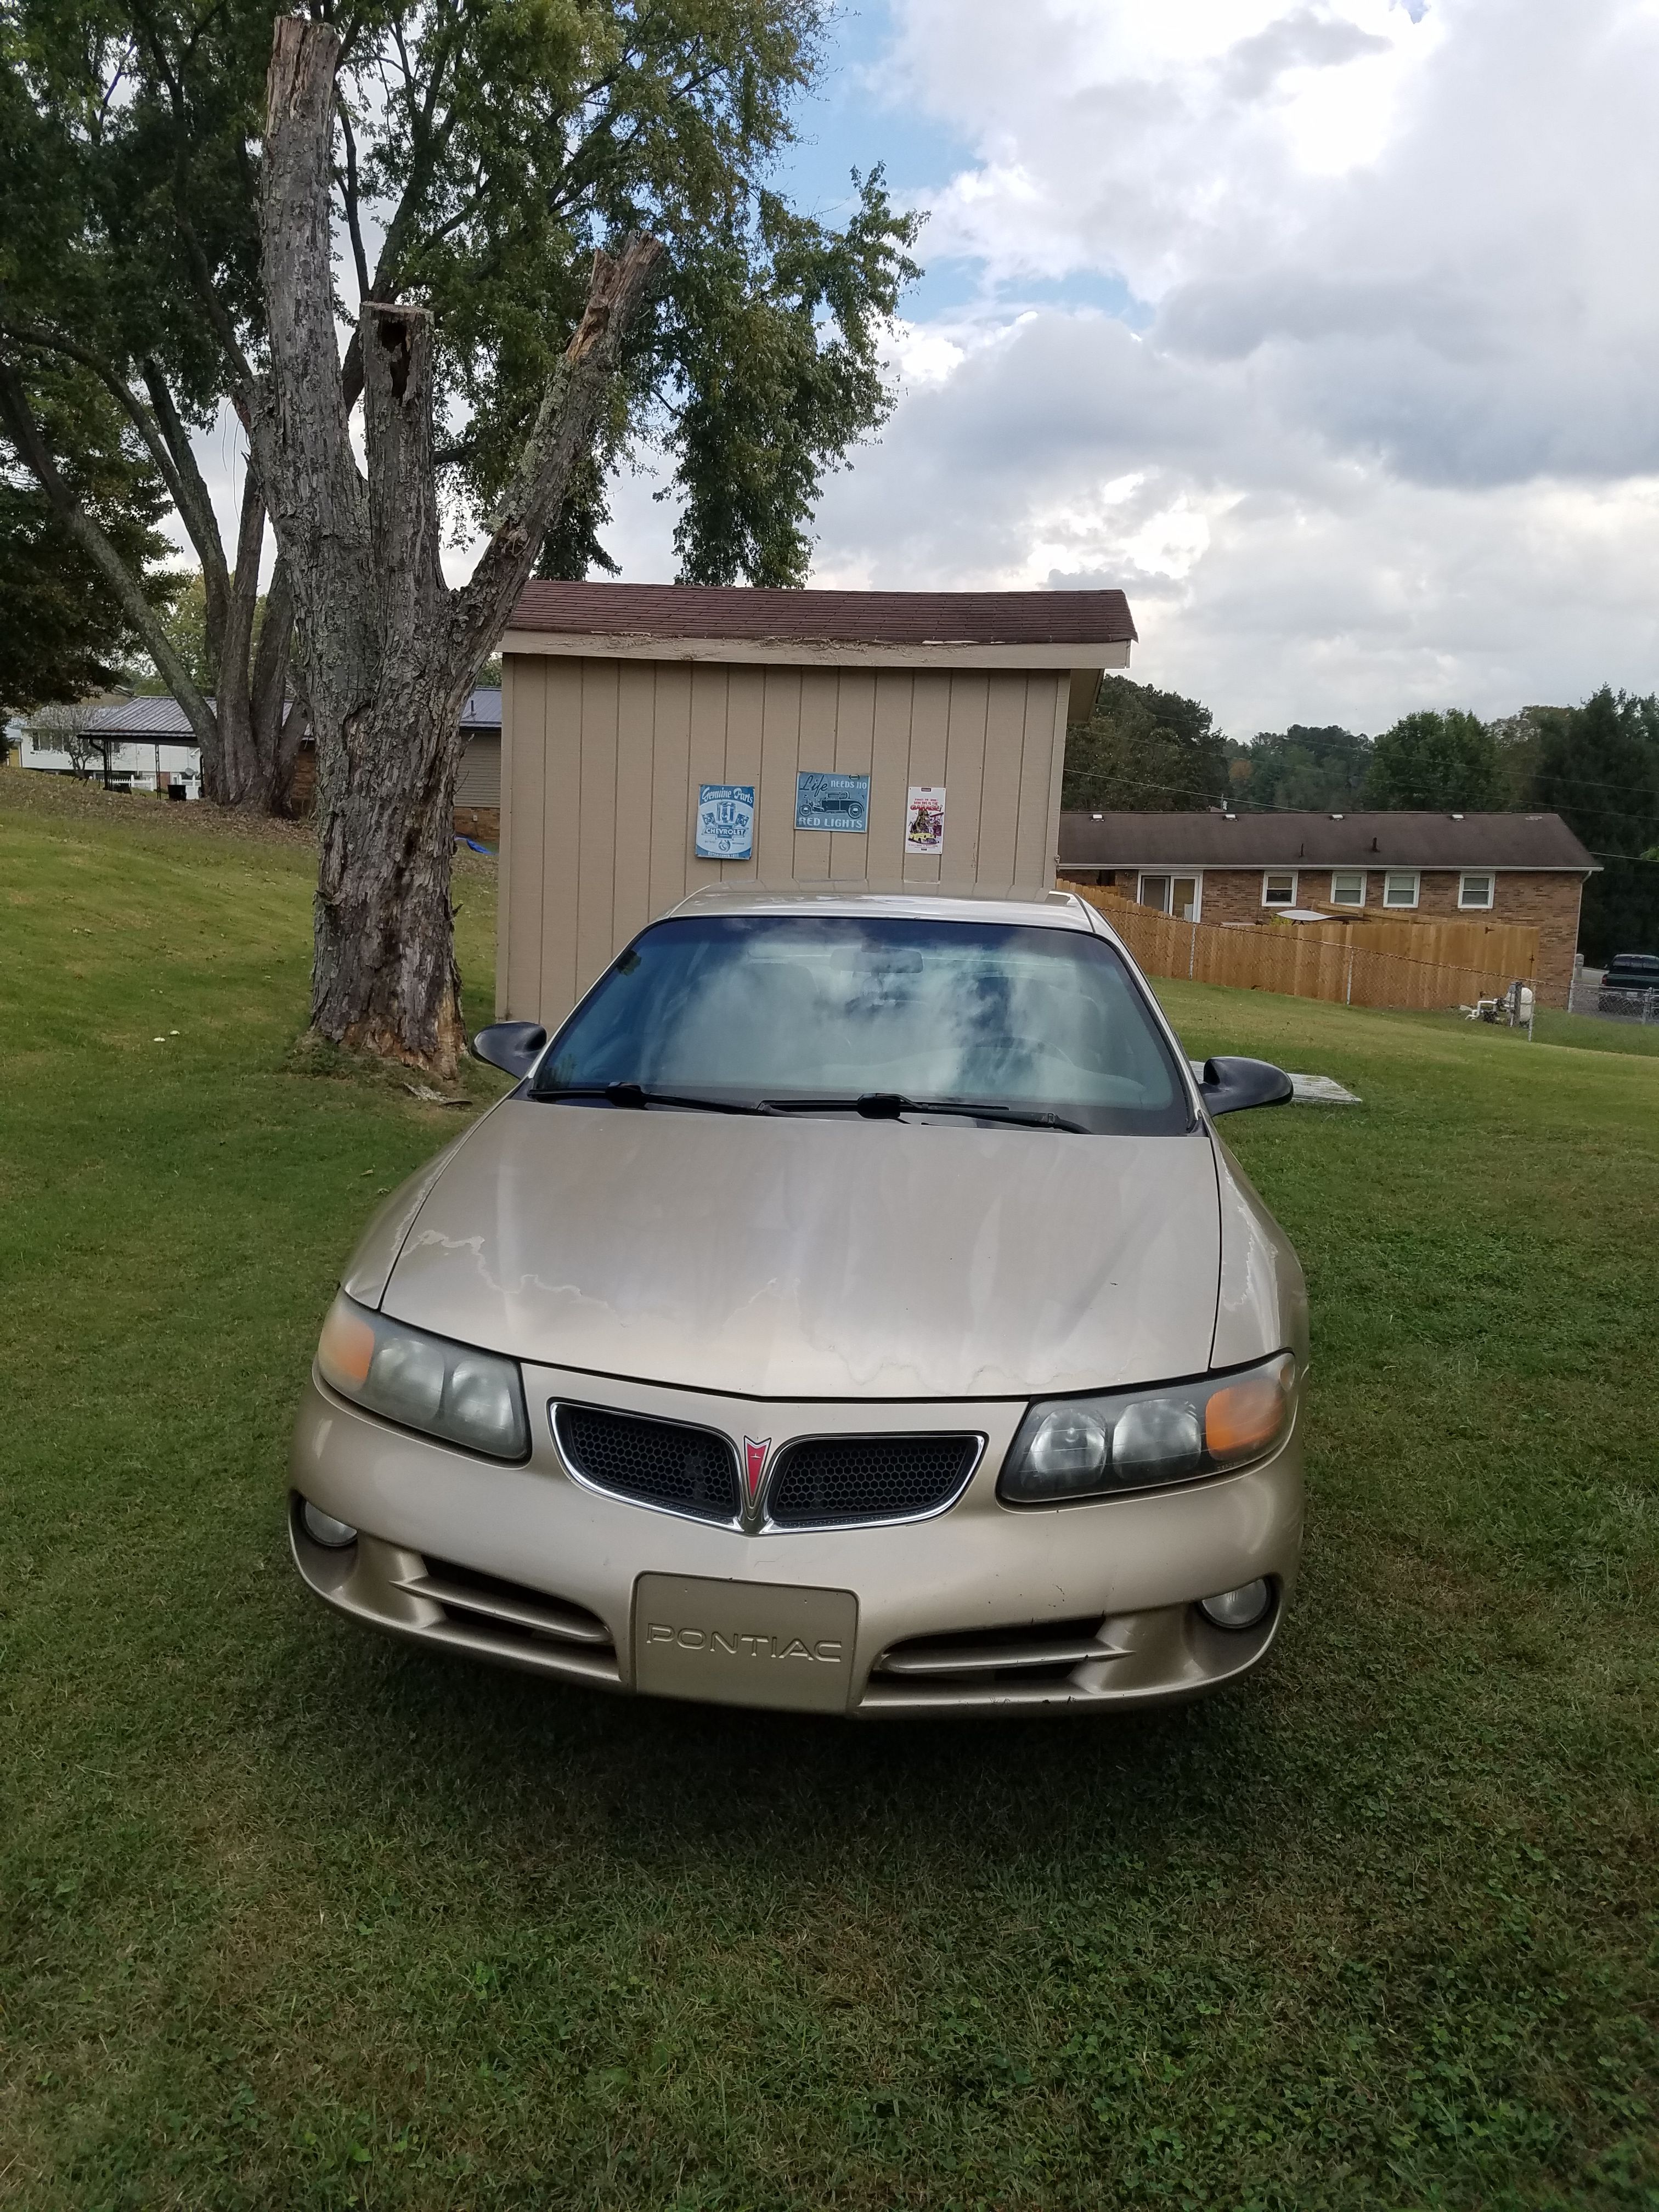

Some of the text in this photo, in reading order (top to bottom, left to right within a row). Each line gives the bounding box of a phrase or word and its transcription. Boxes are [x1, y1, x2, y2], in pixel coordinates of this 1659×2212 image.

[799, 775, 828, 798] Life
[831, 780, 855, 788] NEEDS
[702, 787, 753, 804] Genuine Parts
[799, 817, 862, 828] RED LIGHTS
[706, 827, 745, 836] CHEVROLET
[646, 1623, 842, 1663] PONTIAC
